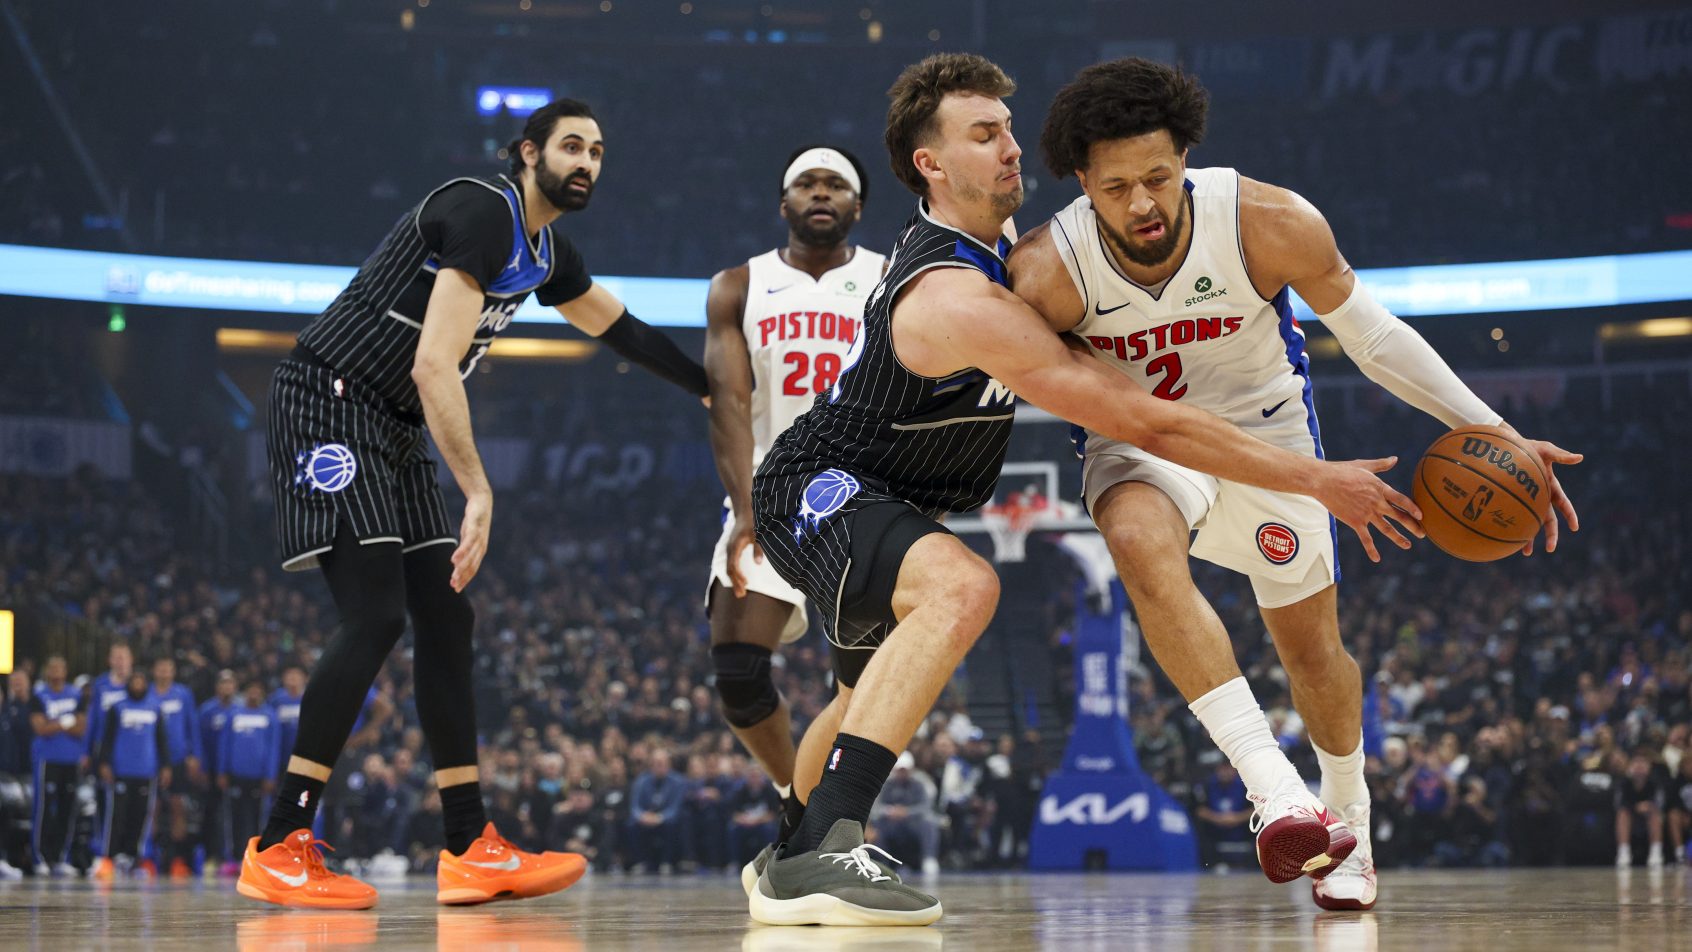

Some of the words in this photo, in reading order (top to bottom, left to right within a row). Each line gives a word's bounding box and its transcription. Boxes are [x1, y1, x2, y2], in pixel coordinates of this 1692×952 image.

[757, 311, 862, 347] PISTON
[1085, 316, 1244, 361] PISTONS
[783, 351, 841, 396] 28
[1145, 351, 1188, 401] 2
[1461, 436, 1540, 501] Wilson
[1264, 533, 1290, 546] DETROIT
[1264, 539, 1289, 553] PISTONS
